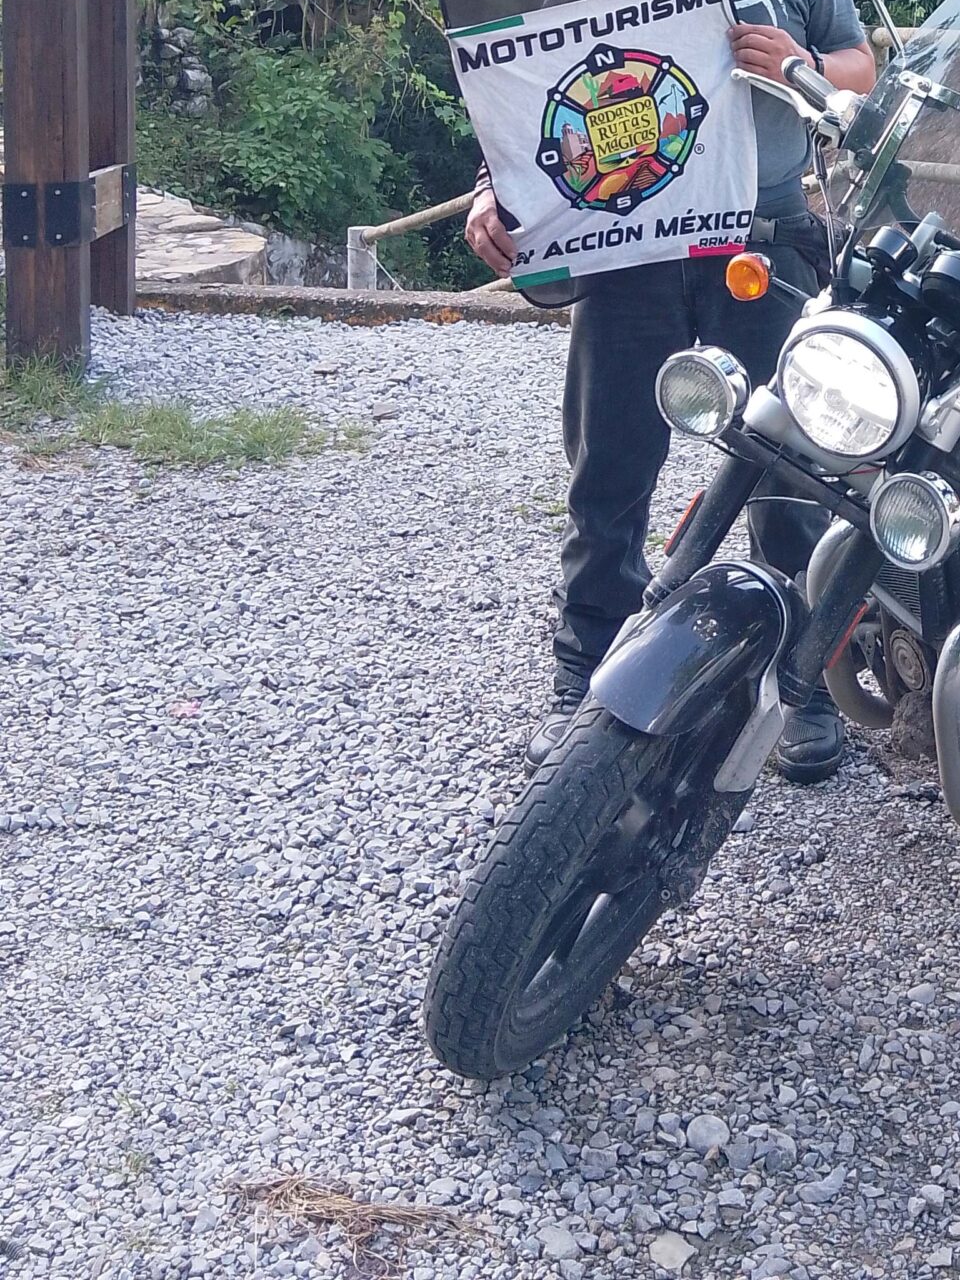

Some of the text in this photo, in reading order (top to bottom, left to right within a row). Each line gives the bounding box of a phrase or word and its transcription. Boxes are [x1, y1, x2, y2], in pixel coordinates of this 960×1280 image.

[595, 50, 615, 67] N
[690, 104, 703, 119] E
[616, 196, 631, 208] S
[542, 221, 643, 260] ACCIÓN
[655, 209, 752, 239] MÉXICO
[699, 235, 729, 248] RRM
